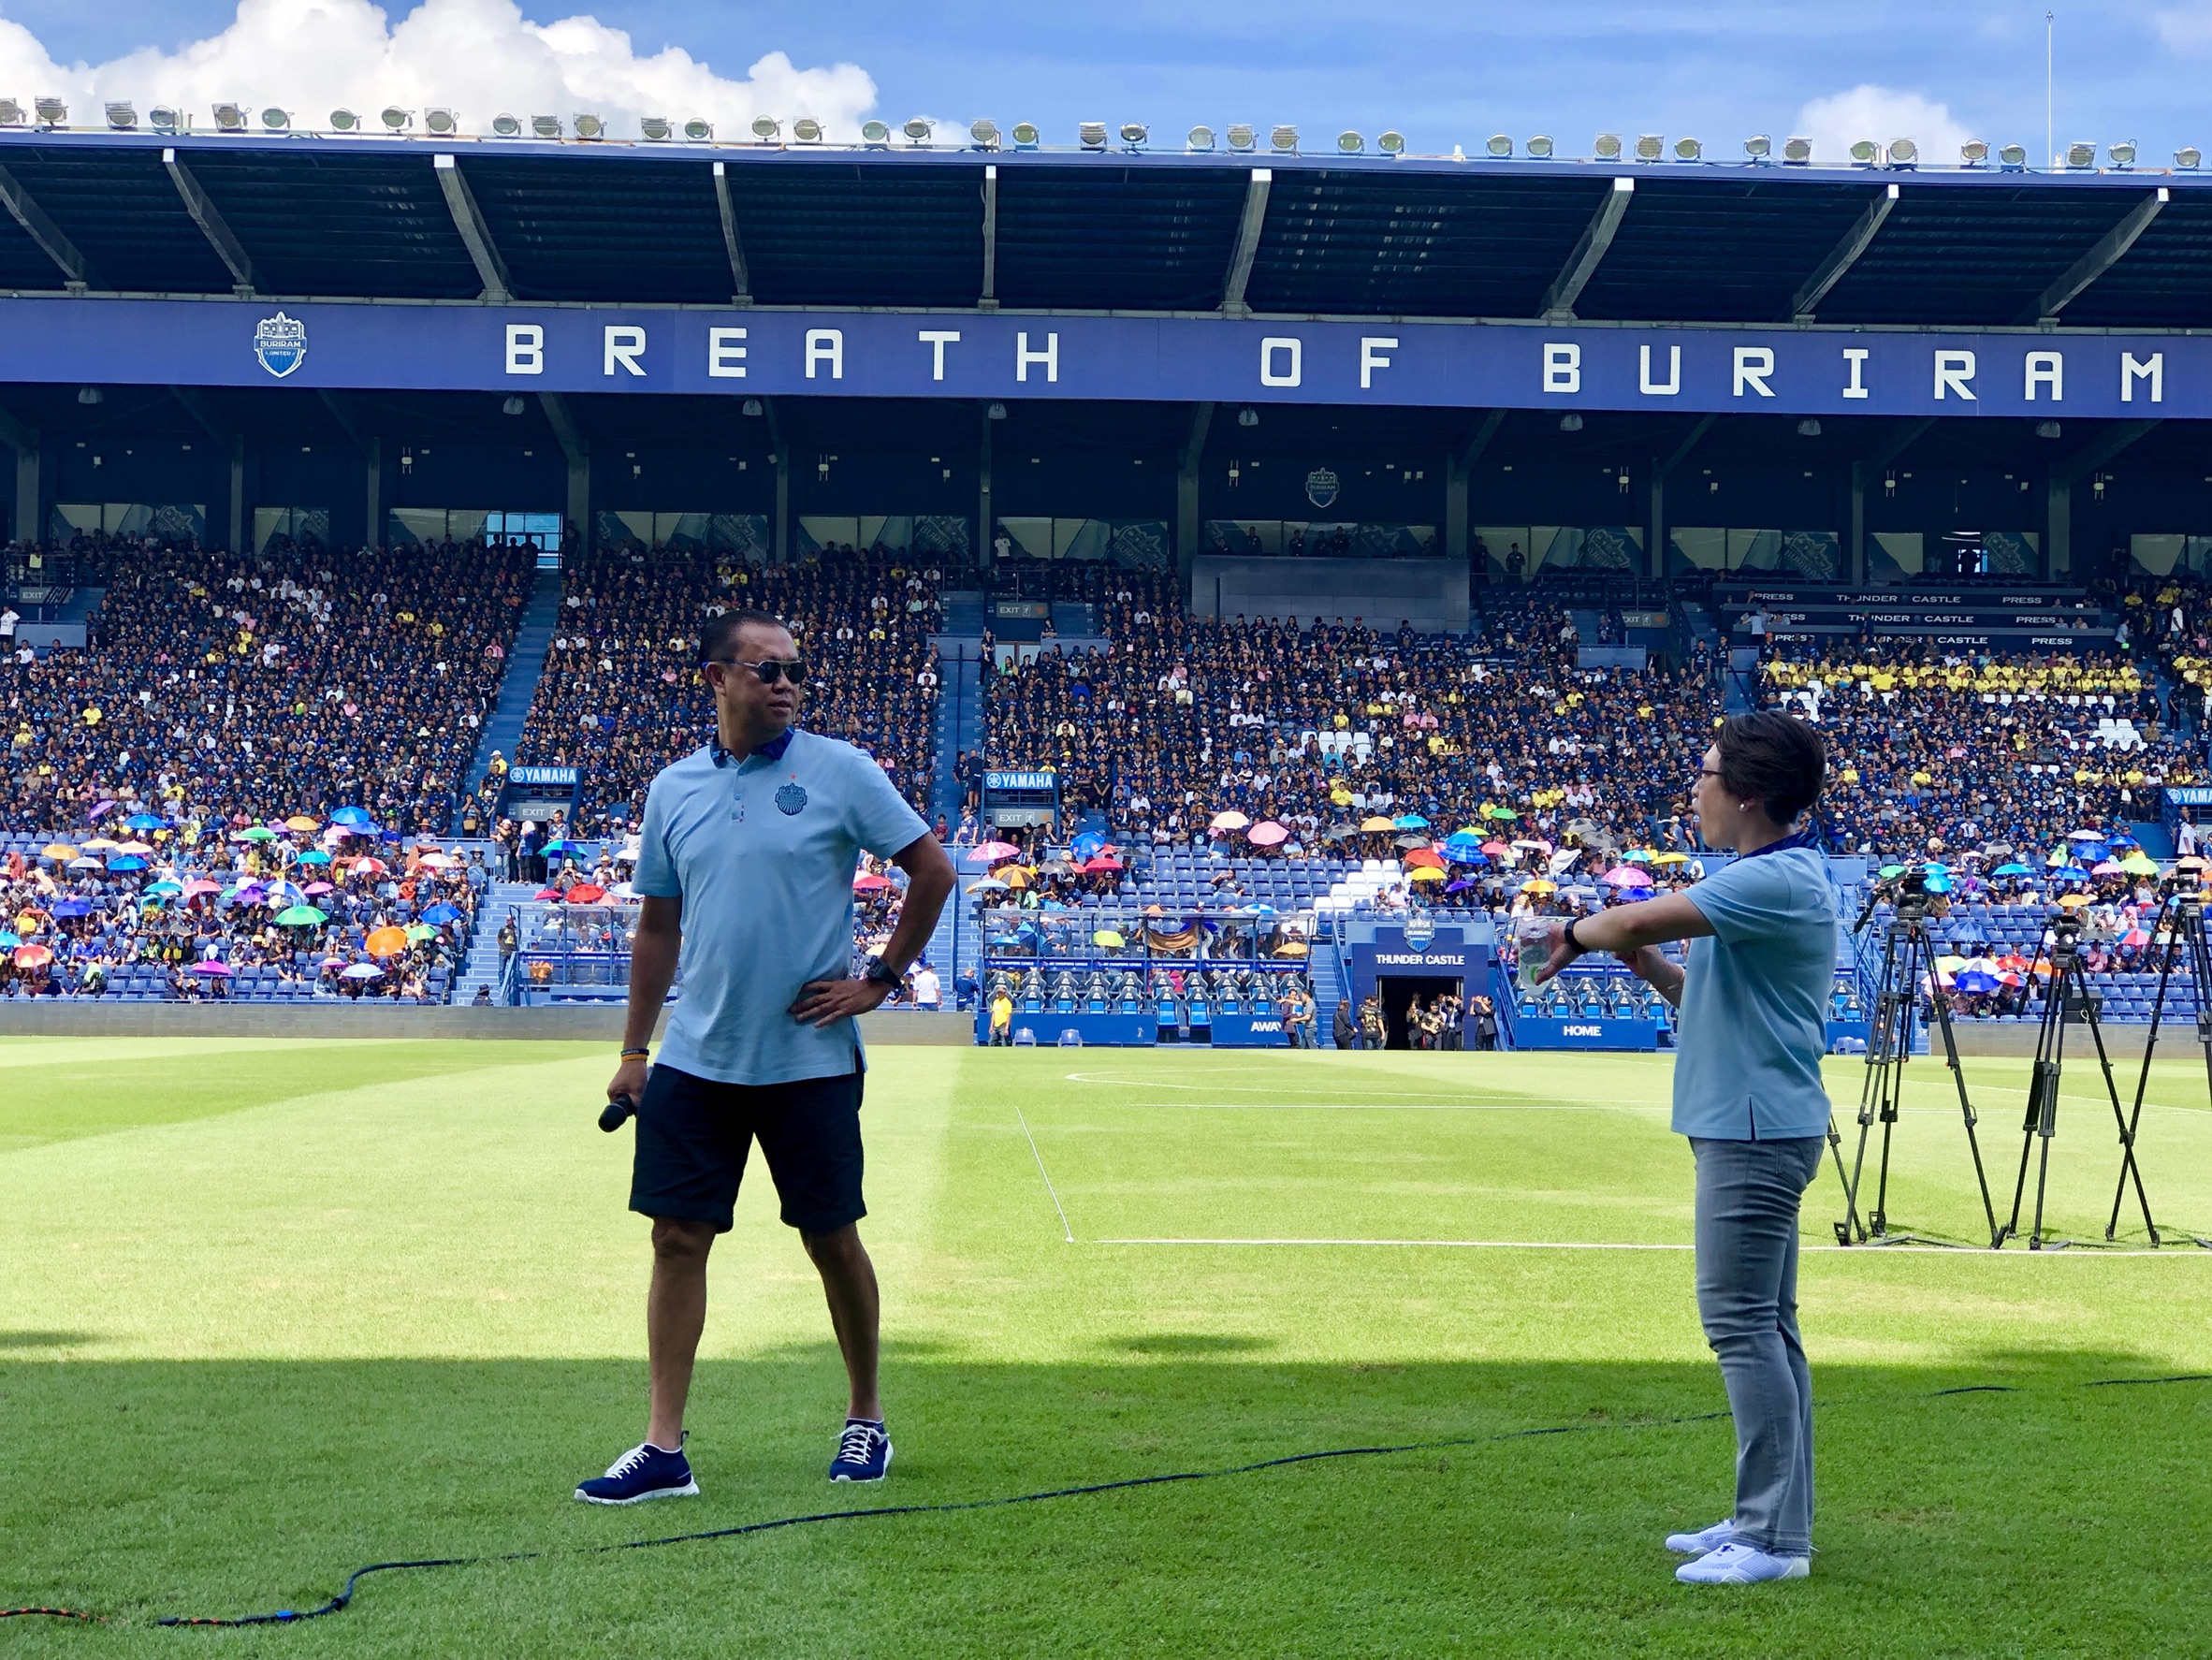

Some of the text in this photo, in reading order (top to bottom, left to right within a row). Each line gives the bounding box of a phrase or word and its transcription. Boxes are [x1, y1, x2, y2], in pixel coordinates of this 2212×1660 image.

[260, 340, 301, 348] BURIRAM
[506, 325, 2163, 402] BREATH OF BURIRAM
[2016, 616, 2056, 624] PRESS
[1937, 636, 1988, 645] CASTLE
[2031, 637, 2073, 646] PRESS
[525, 768, 576, 782] YAMAHA
[1002, 774, 1053, 788] YAMAHA
[1375, 954, 1465, 966] THUNDER CASTLE
[1564, 1026, 1602, 1037] HOME
